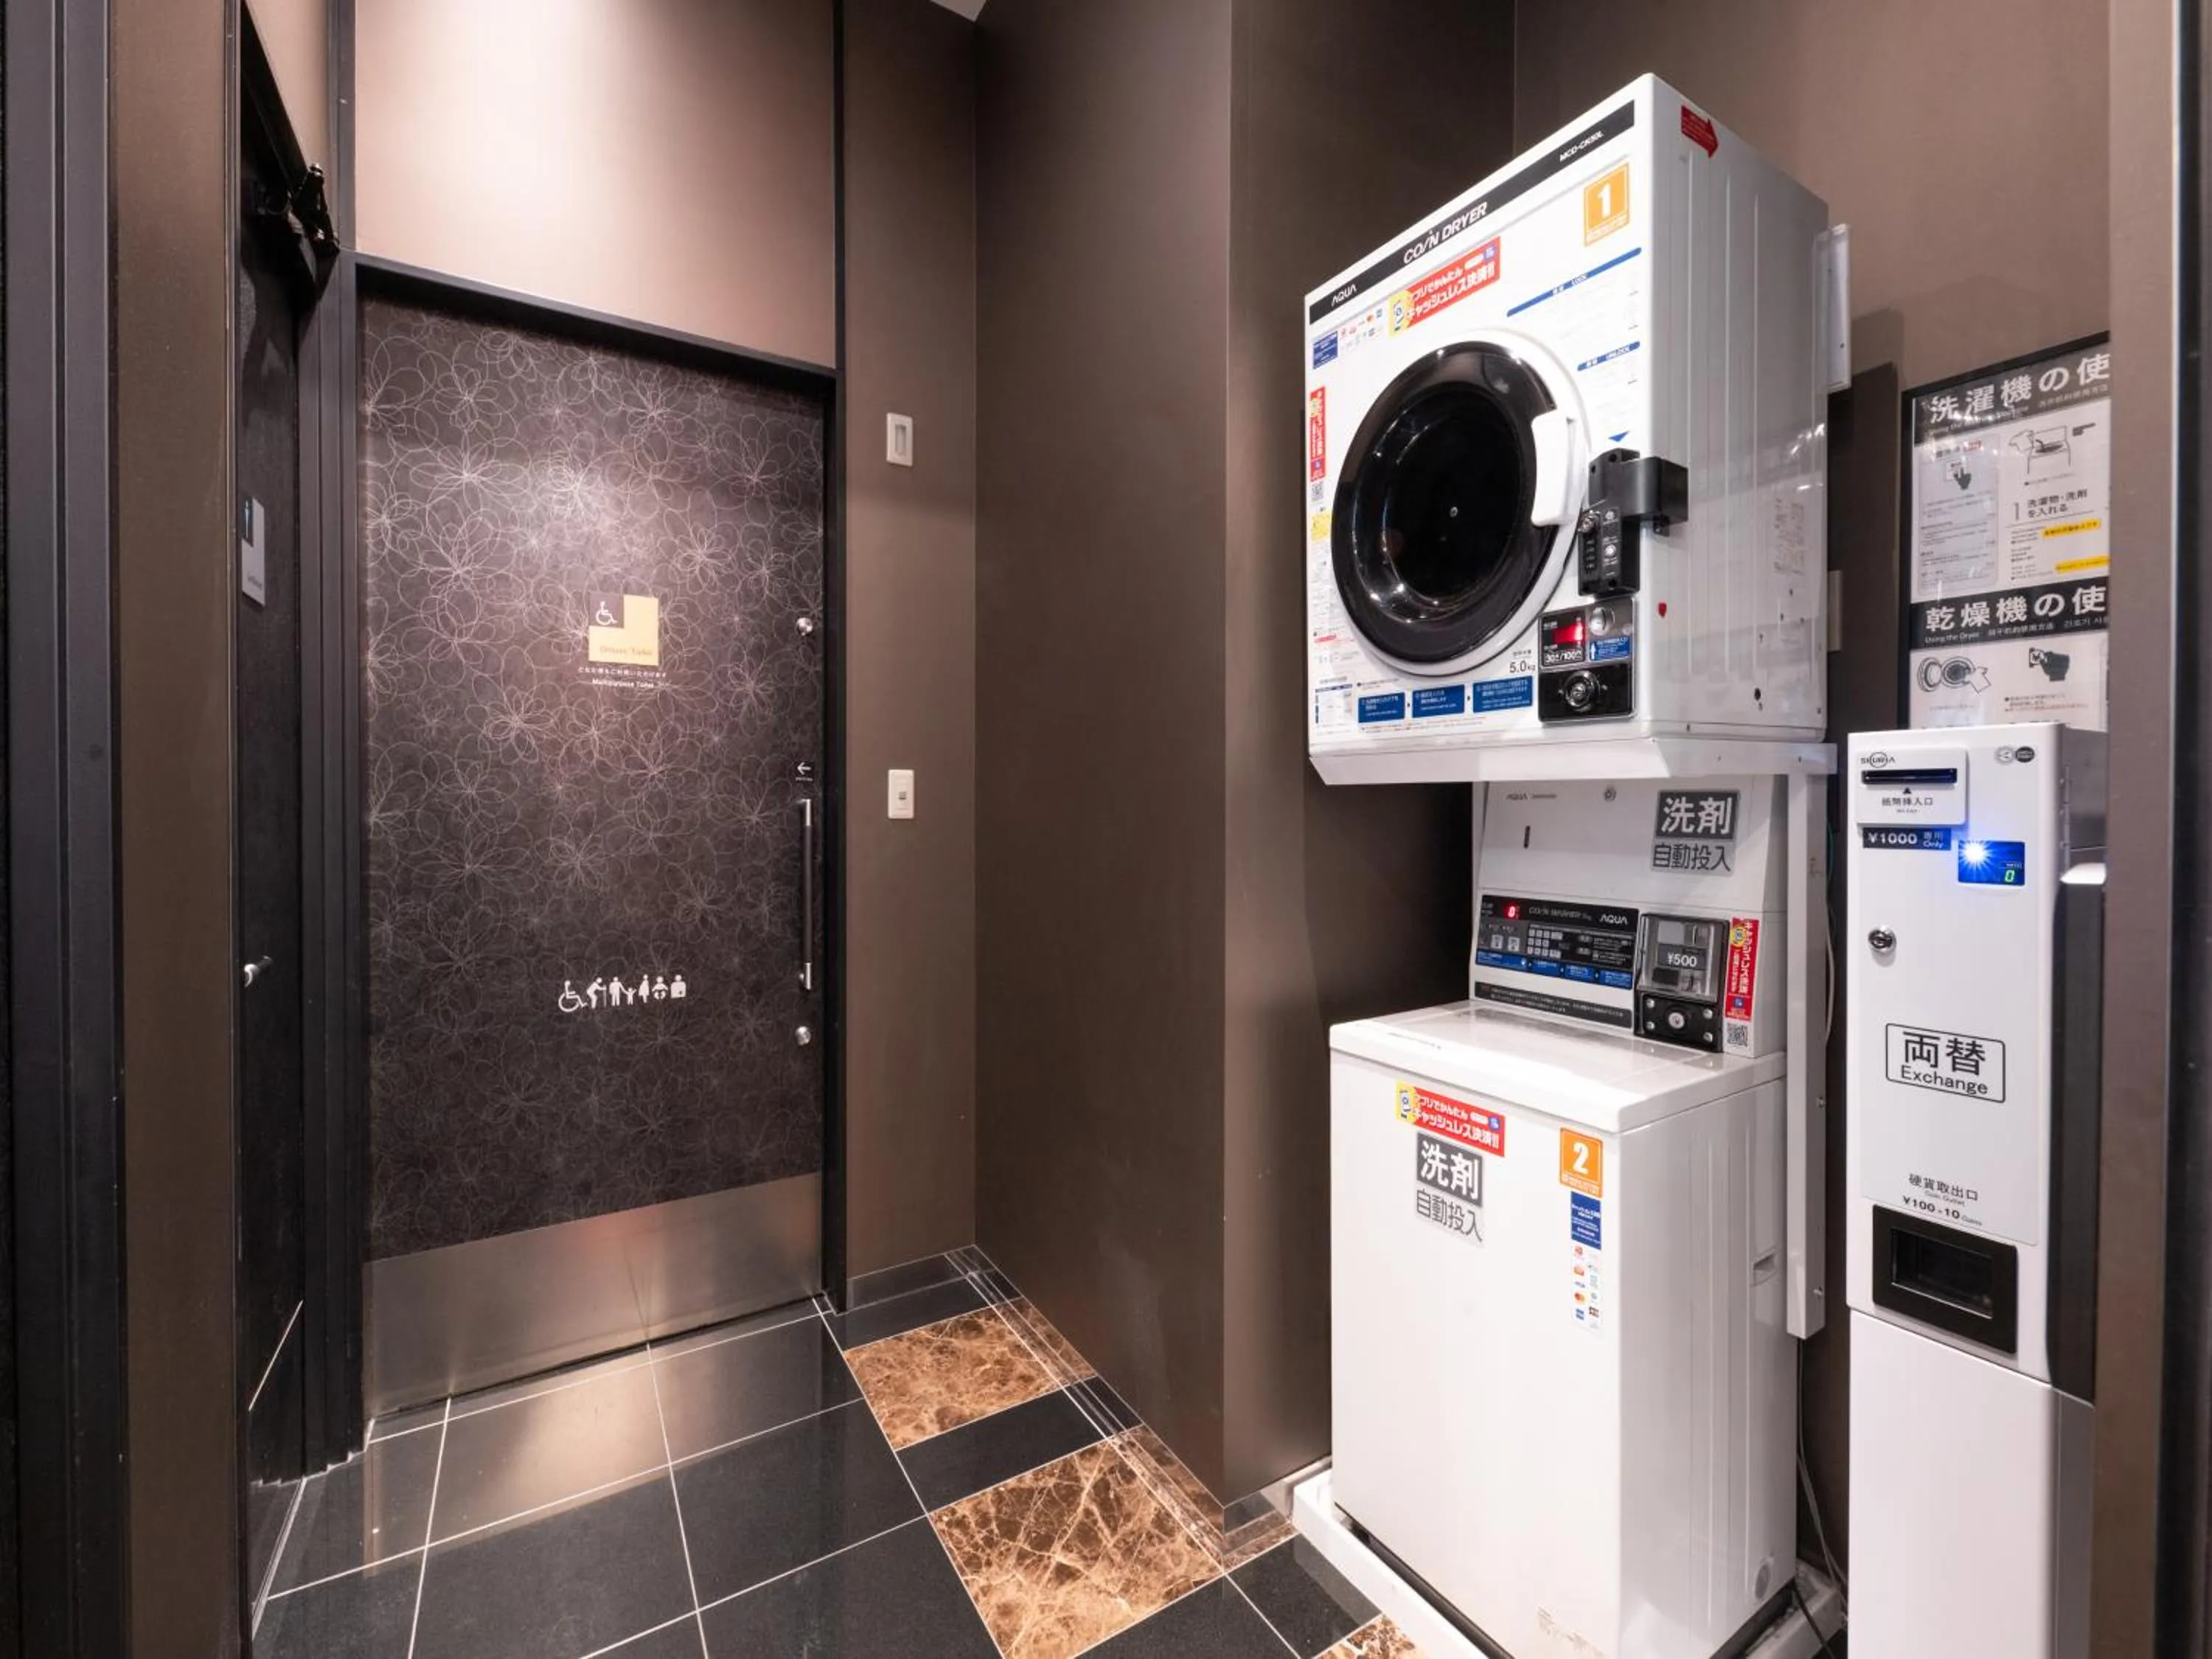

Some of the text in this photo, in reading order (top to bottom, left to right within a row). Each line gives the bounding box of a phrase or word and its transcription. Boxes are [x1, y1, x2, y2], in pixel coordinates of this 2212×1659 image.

[1597, 182, 1611, 218] 1
[1403, 229, 1440, 264] COIN
[1441, 201, 1488, 241] DRYER
[1331, 283, 1357, 307] AQUA
[1924, 585, 2106, 632] 乾燥機の使
[1660, 796, 1733, 835] 洗剤
[1868, 832, 1918, 844] ¥1000
[1923, 840, 1944, 849] Only
[1652, 841, 1731, 872] 自動投入
[2005, 869, 2015, 883] 0
[1599, 914, 1628, 925] AQUA
[1667, 951, 1697, 967] ¥500
[1902, 1030, 1986, 1077] 両替
[1900, 1064, 1989, 1095] Exchange
[1421, 1140, 1478, 1200] 洗剤
[1573, 1141, 1590, 1175] 2
[1909, 1173, 1978, 1201] 硬貨取出口
[1416, 1188, 1483, 1242] 自動投入
